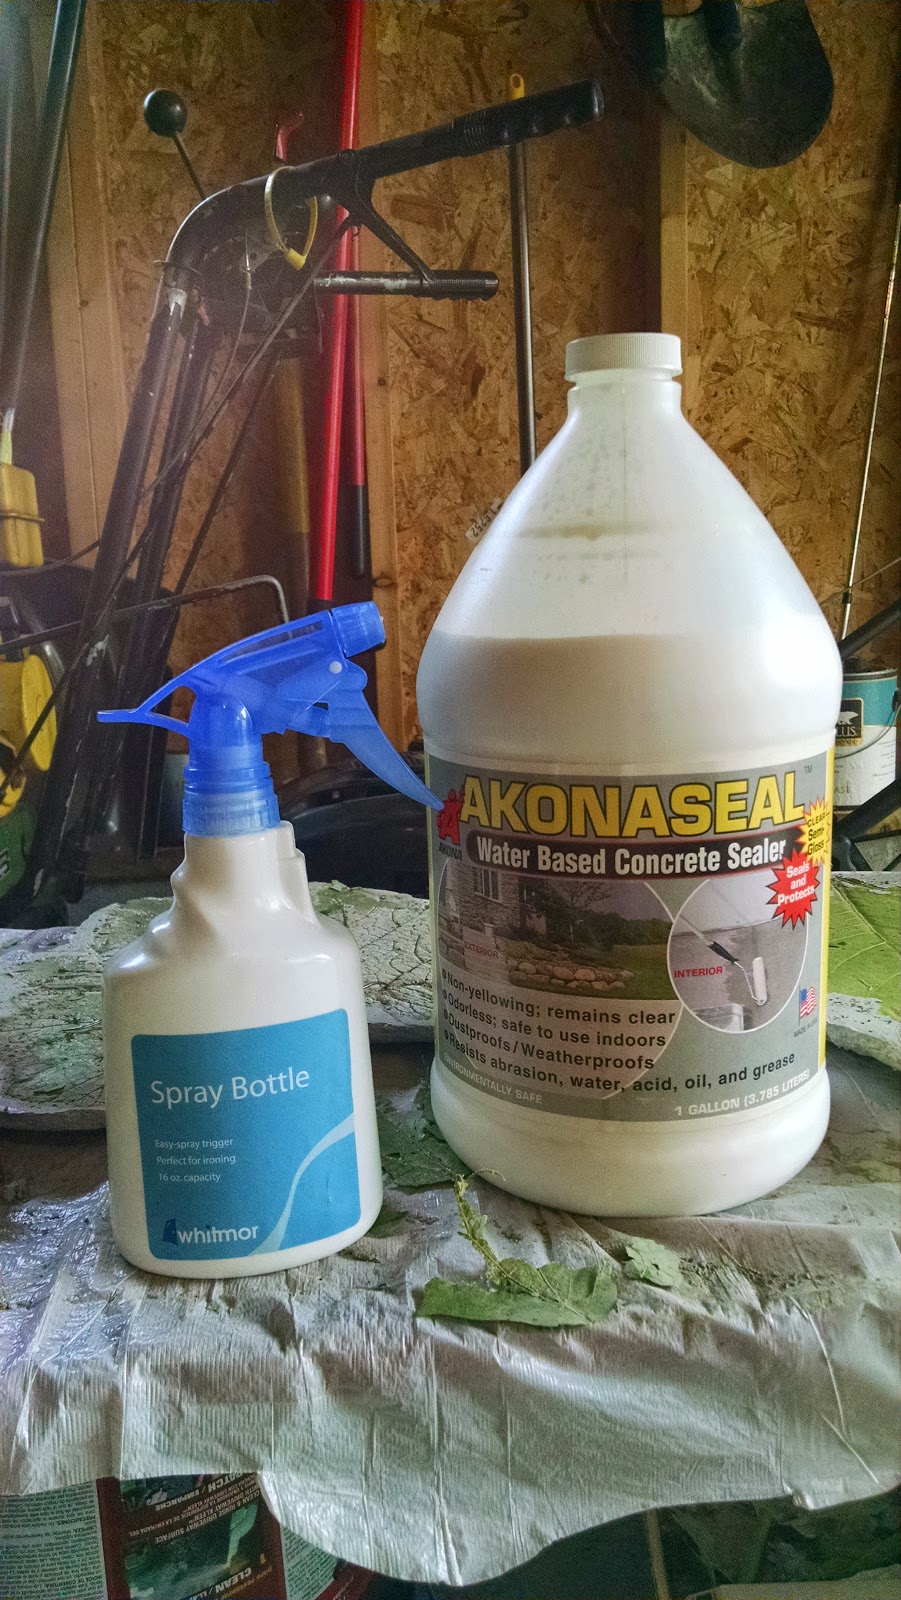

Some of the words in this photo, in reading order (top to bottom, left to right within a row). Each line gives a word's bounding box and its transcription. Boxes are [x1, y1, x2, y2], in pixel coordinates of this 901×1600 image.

[836, 726, 857, 738] LUS
[460, 771, 805, 838] AKONASEAL
[807, 814, 827, 828] CLEAR
[808, 824, 825, 841] Semi-
[476, 836, 530, 869] Water
[537, 845, 606, 875] Based
[614, 846, 721, 876] Concrete
[727, 837, 786, 870] Sealer
[807, 839, 825, 856] Gloss
[786, 861, 810, 878] Seals
[790, 875, 807, 890] and
[777, 886, 815, 906] Protects
[464, 941, 499, 958] EXTERIOR
[674, 966, 723, 978] INTERIOR
[447, 971, 541, 1017] Non-yellowing;
[547, 1006, 621, 1024] remains
[628, 1010, 675, 1024] clear
[448, 992, 497, 1029] Odorless;
[501, 1018, 532, 1036] safe
[537, 1025, 553, 1039] to
[559, 1031, 590, 1044] use
[596, 1032, 666, 1047] indoors
[450, 1034, 487, 1064] Resists
[491, 1057, 564, 1087] abrasion,
[569, 1076, 626, 1092] water,
[633, 1077, 678, 1092] acid,
[684, 1074, 712, 1089] oil,
[718, 1068, 748, 1085] and
[753, 1053, 796, 1080] grease
[444, 1053, 512, 1096] ENVIRONMENTALLY
[515, 1088, 543, 1104] SAFE
[150, 1081, 223, 1110] Spray
[231, 1067, 310, 1100] Bottle
[674, 1105, 682, 1117] 1
[688, 1097, 740, 1116] GALLON
[743, 1086, 779, 1108] (3.785
[782, 1068, 810, 1092] LITERS)
[155, 1139, 200, 1150] Easy-spray
[202, 1138, 234, 1150] trigger
[156, 1156, 187, 1165] Perfect
[188, 1156, 201, 1165] for
[202, 1155, 236, 1166] ironing
[158, 1173, 169, 1182] 16
[170, 1174, 183, 1182] oz.
[183, 1173, 221, 1184] capacity
[177, 1224, 259, 1244] whitmor
[214, 1492, 244, 1511] DRIVEWAY
[186, 1511, 218, 1532] DRIVEWAY
[155, 1528, 185, 1544] SURFACE
[215, 1567, 252, 1594] CLEAN
